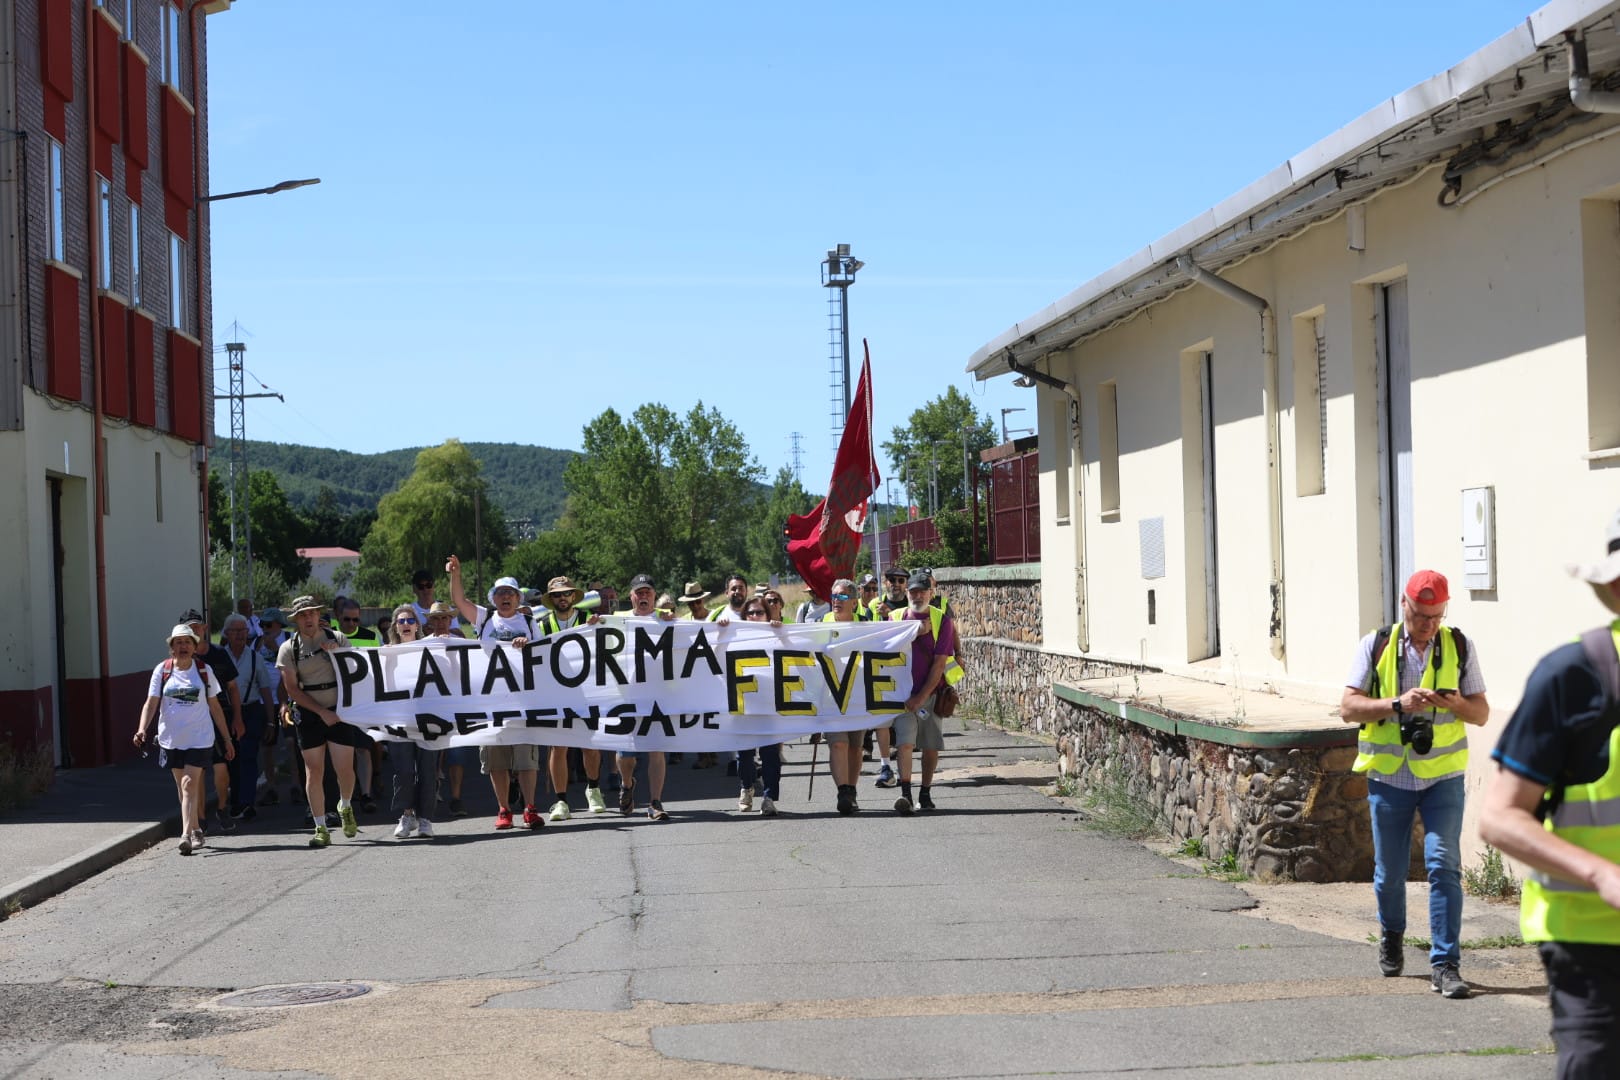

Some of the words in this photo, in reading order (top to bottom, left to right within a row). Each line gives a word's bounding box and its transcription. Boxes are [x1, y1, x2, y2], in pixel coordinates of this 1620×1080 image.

[334, 626, 723, 707] PLATAFORMA
[679, 711, 720, 730] DE
[725, 649, 907, 716] FEVE
